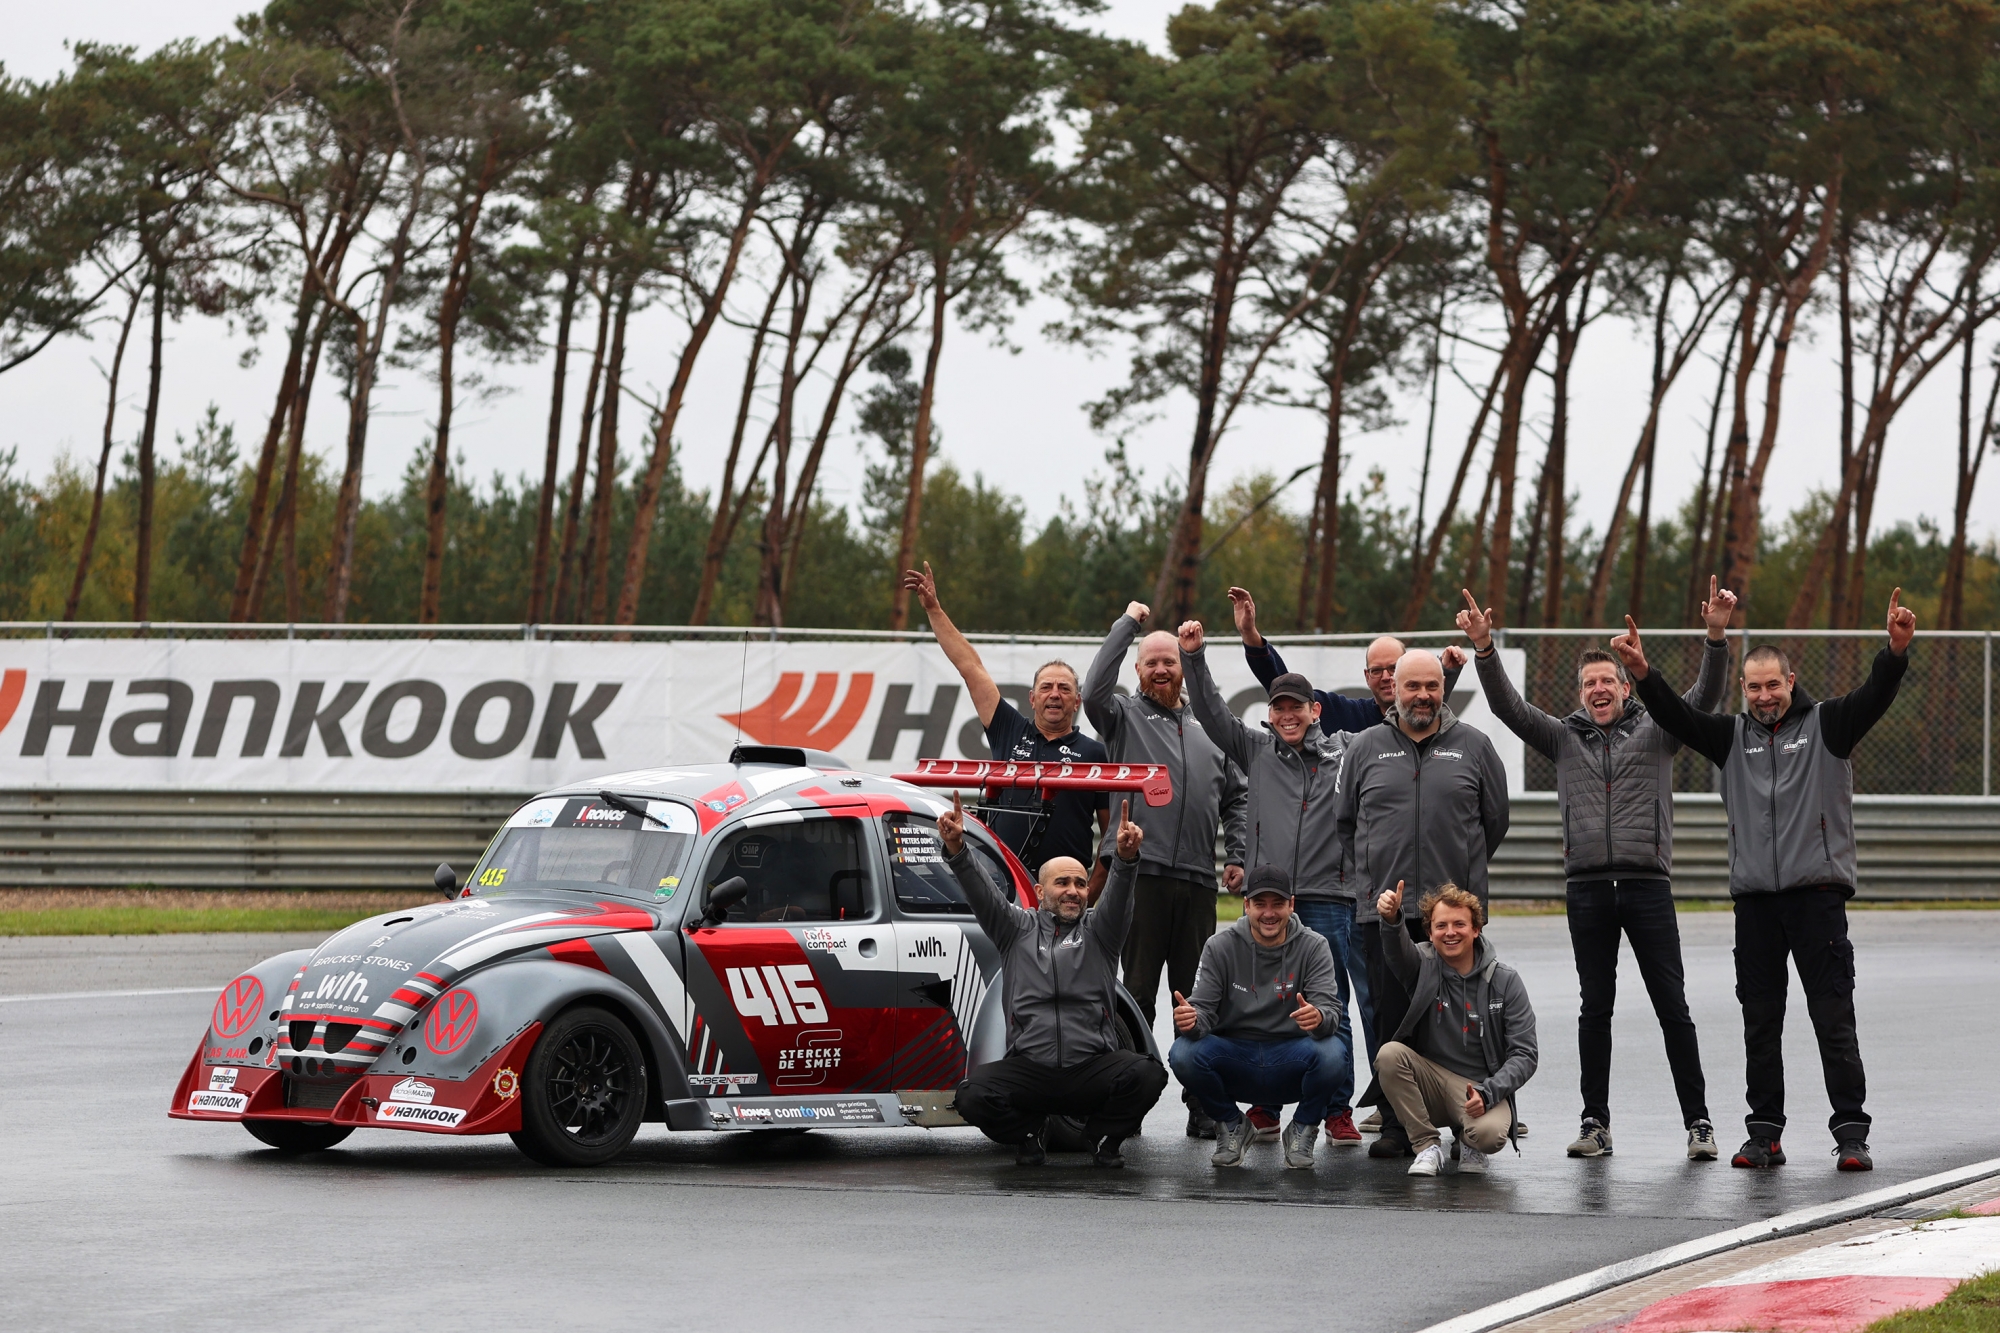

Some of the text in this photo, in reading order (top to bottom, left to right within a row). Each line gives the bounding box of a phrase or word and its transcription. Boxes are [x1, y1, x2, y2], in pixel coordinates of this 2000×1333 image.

[576, 803, 628, 821] KRONOS
[741, 845, 759, 855] OMP
[478, 868, 507, 886] 415
[808, 938, 847, 952] compact
[313, 955, 357, 968] BRICKS
[363, 955, 413, 972] STONES
[725, 964, 829, 1026] 415
[779, 1048, 841, 1059] STERCKX
[779, 1058, 841, 1070] DE SMET
[733, 1104, 836, 1119] KRONOS comtoyou
